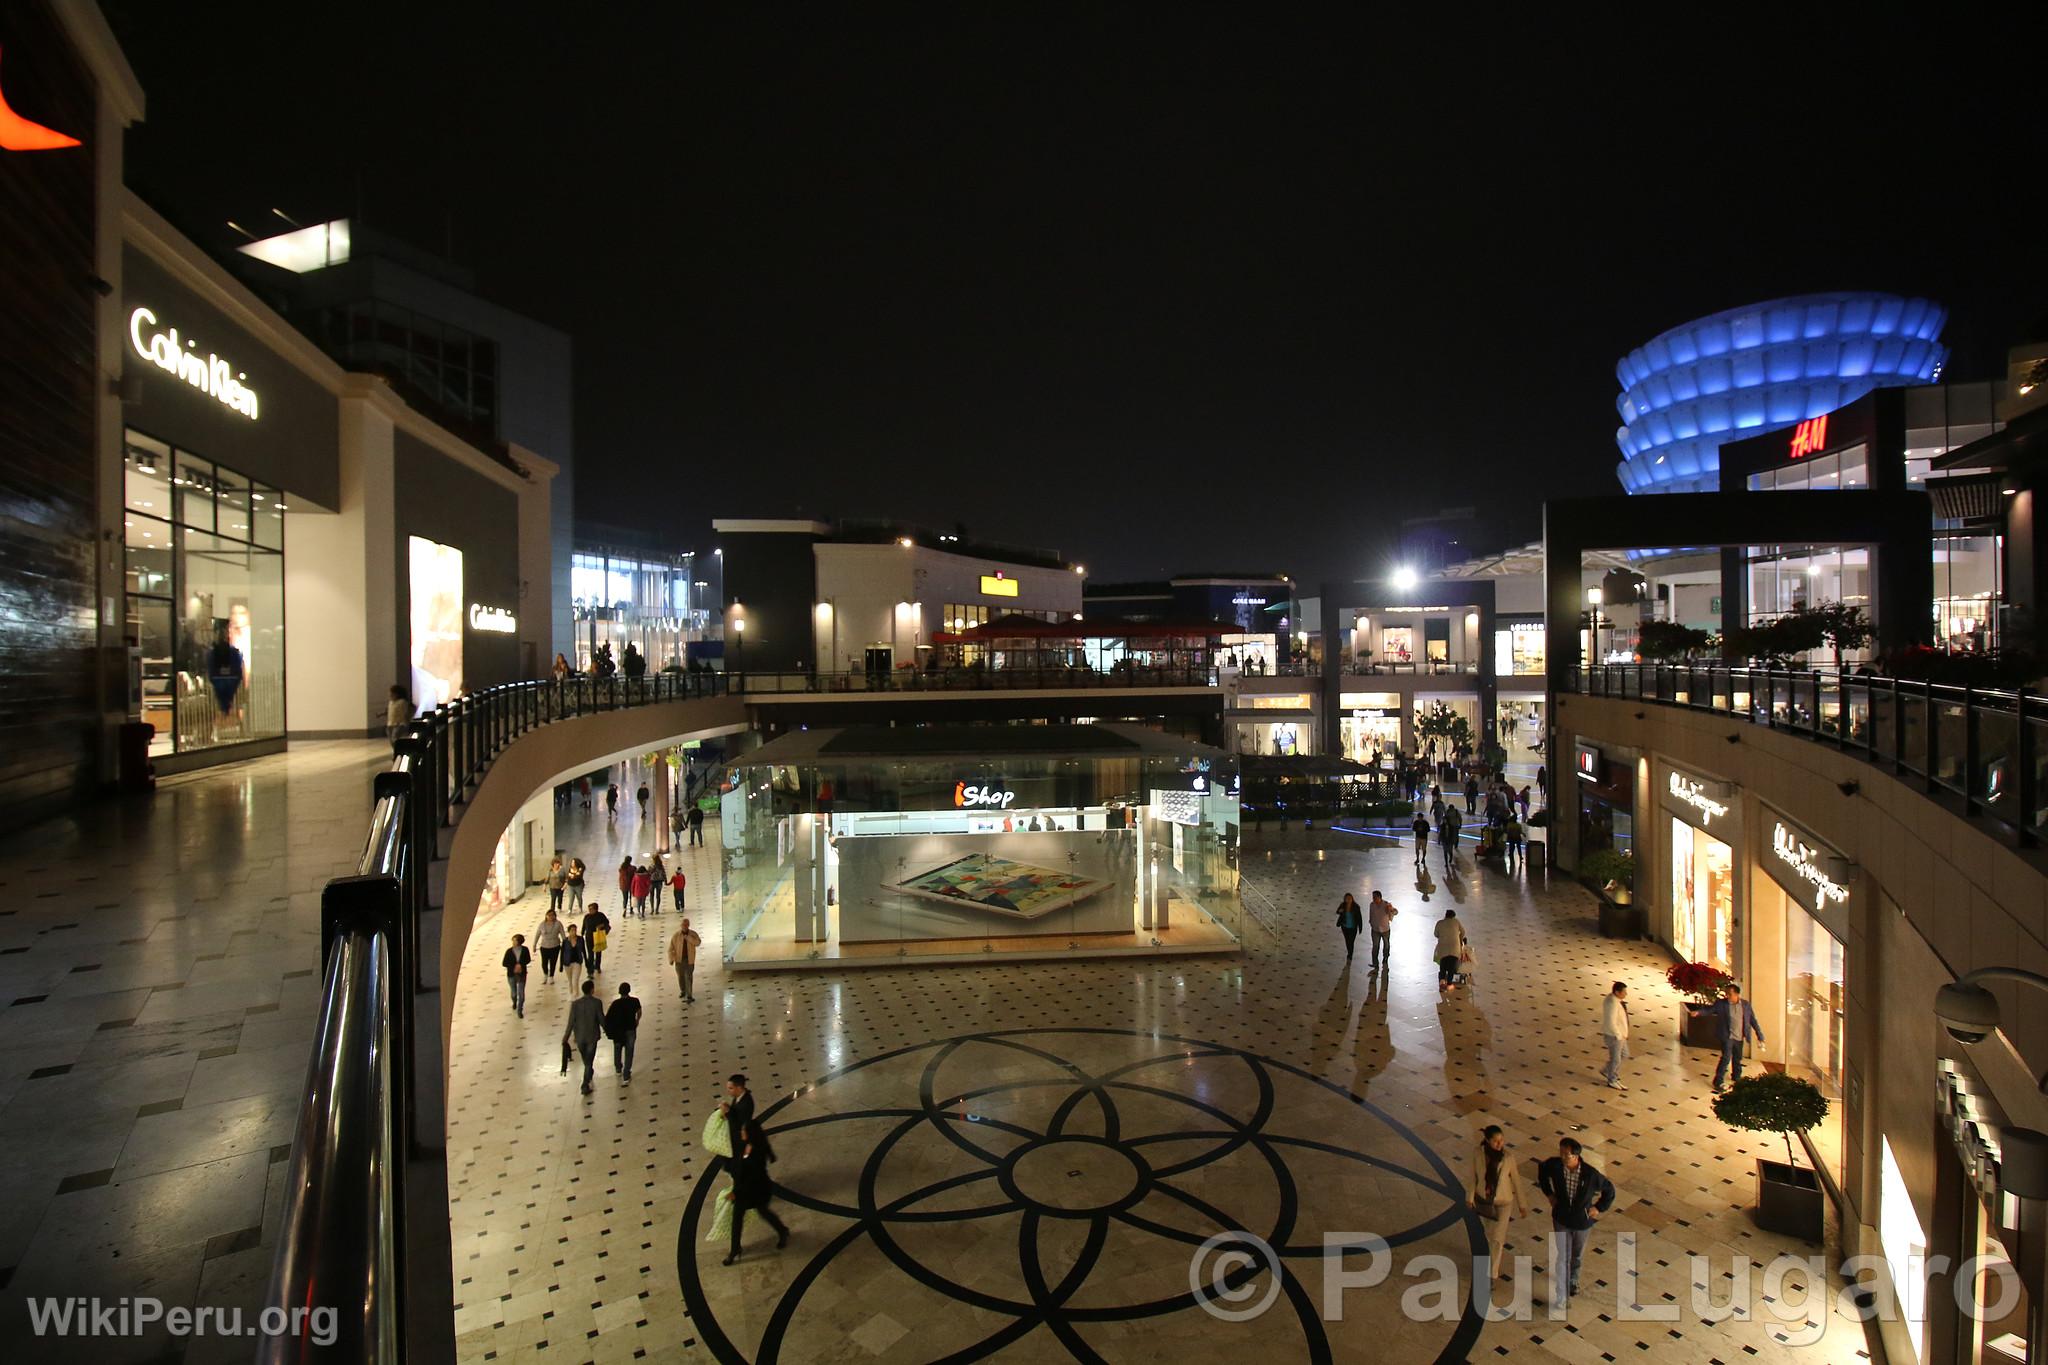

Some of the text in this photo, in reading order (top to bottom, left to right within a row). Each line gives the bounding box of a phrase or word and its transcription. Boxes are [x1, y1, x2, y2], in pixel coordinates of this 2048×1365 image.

[131, 307, 258, 420] Calvin Klein
[1791, 414, 1828, 458] H&M
[954, 780, 1015, 809] iShop
